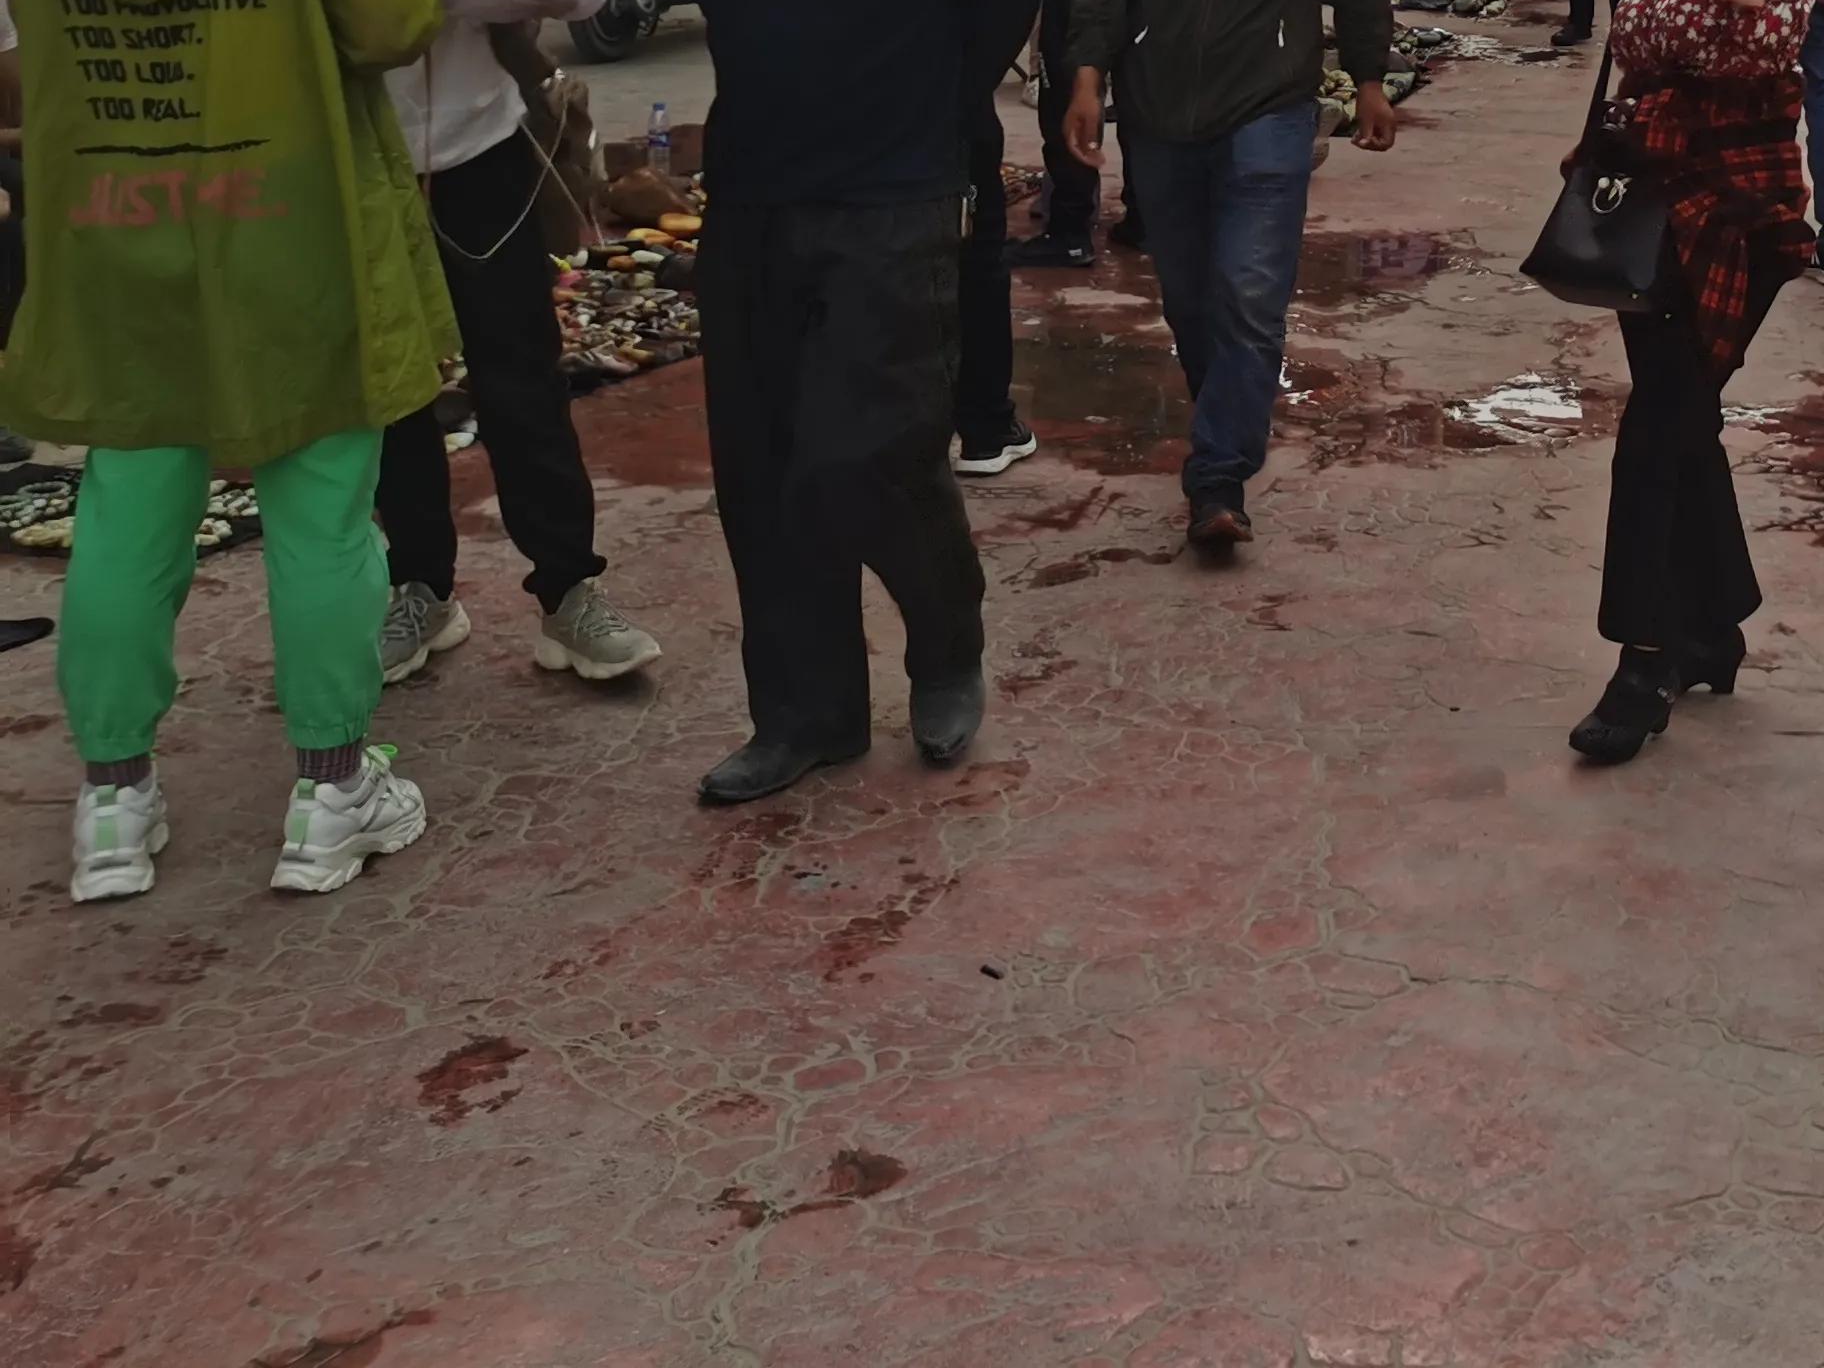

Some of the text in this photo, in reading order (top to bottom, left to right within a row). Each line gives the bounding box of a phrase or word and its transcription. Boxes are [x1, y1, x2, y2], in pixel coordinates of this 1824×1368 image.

[64, 24, 116, 49] TOO
[76, 58, 127, 83] TOO
[85, 96, 135, 121] TOO
[69, 170, 190, 227] JUST
